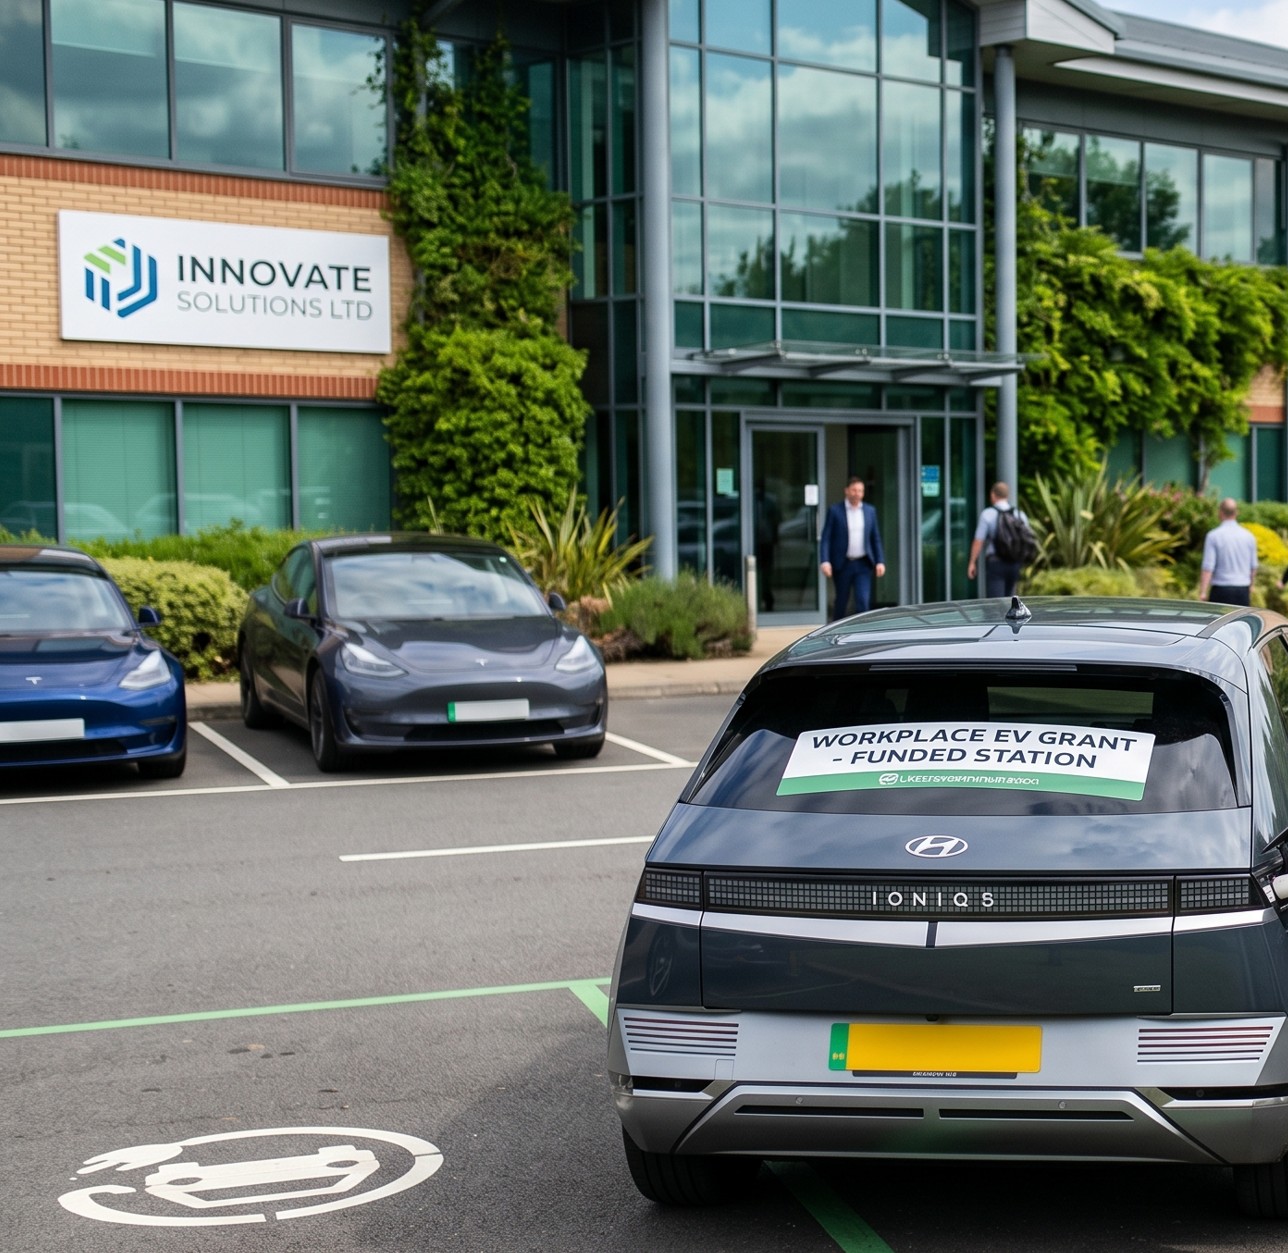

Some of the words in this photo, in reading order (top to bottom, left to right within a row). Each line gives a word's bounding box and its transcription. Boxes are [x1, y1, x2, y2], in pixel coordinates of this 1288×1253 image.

[177, 255, 372, 293] INNOVATE
[176, 290, 322, 318] SOLUTIONS
[330, 299, 373, 321] LTD
[811, 728, 987, 749] WORKPLACE
[993, 729, 1033, 744] EV
[1038, 731, 1138, 752] GRANT
[850, 748, 967, 765] FUNDED
[973, 748, 1098, 768] STATION
